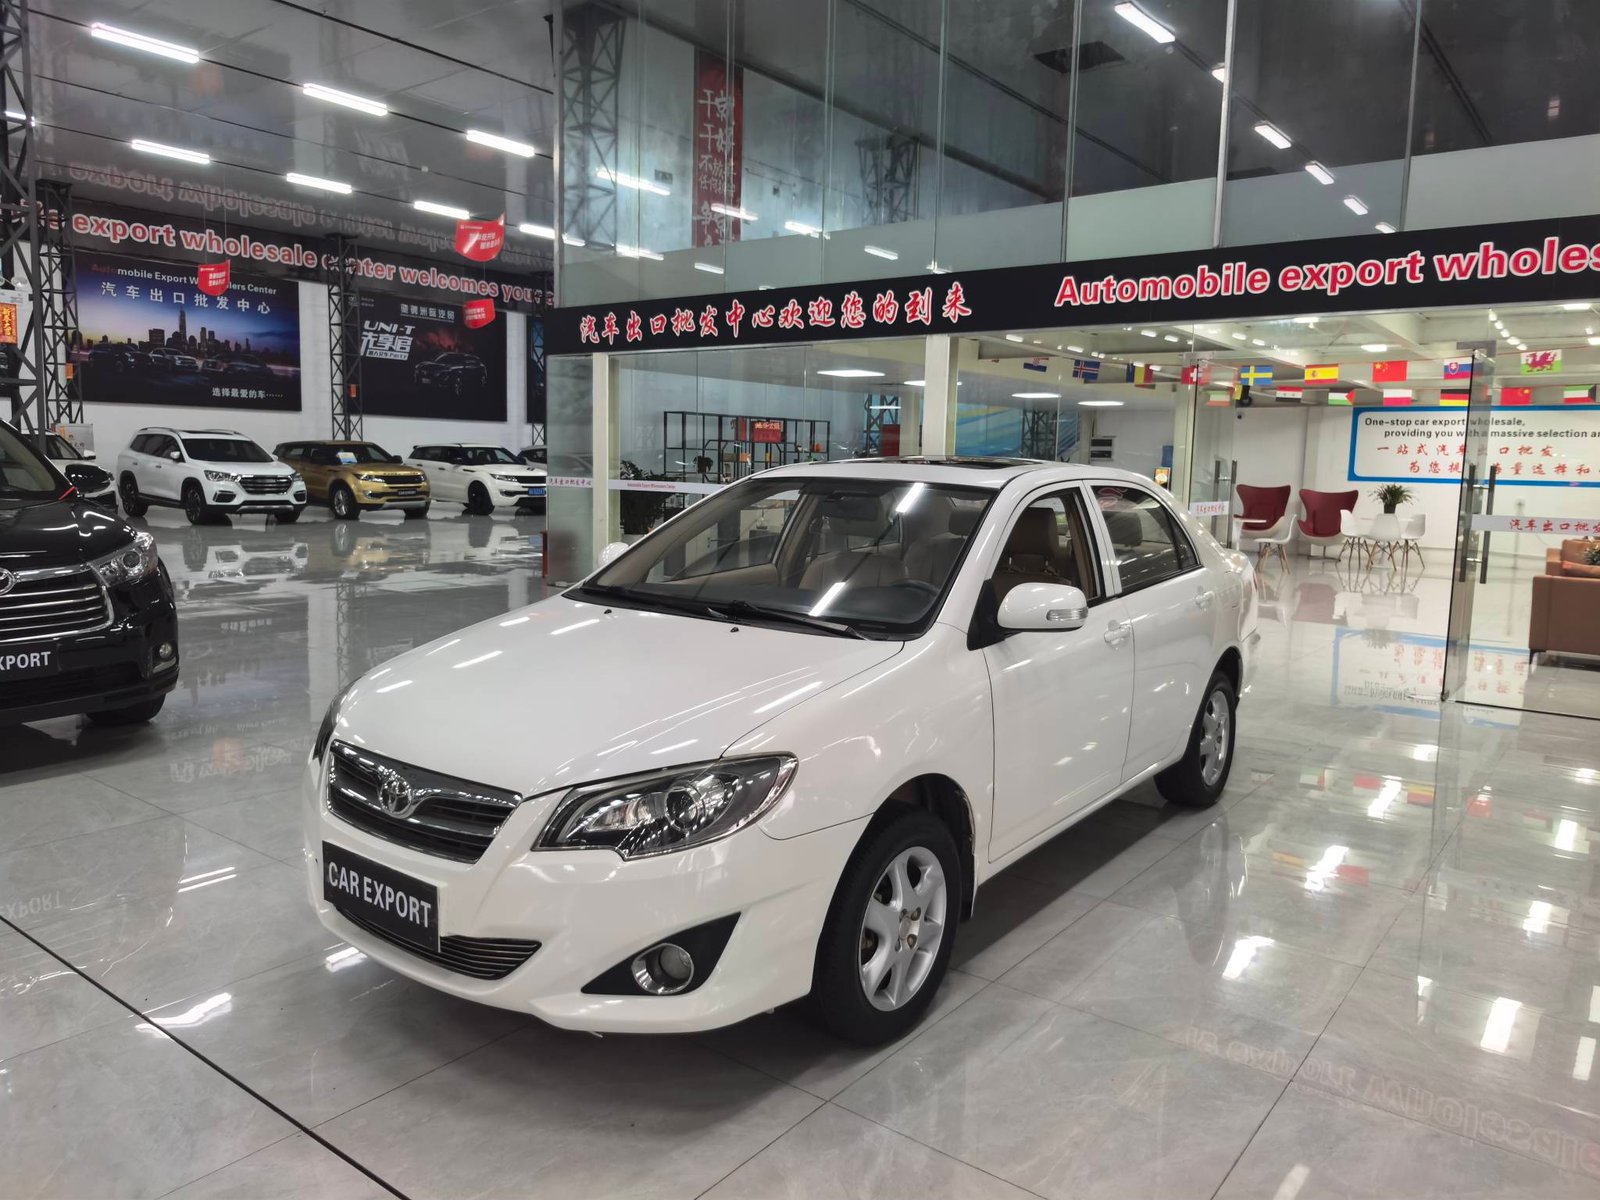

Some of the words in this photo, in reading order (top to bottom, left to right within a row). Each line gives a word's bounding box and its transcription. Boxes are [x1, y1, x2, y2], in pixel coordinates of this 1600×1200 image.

[72, 213, 176, 247] export
[180, 229, 317, 270] wholesale
[399, 266, 499, 298] welcomes
[92, 264, 153, 279] Automobile
[154, 271, 188, 284] Export
[247, 283, 277, 295] Center
[1054, 261, 1270, 307] Automobile
[1278, 250, 1425, 295] export
[101, 281, 271, 315] 汽车出口批发中心
[579, 281, 972, 345] 汽车出口批发中心欢迎您的到来
[363, 320, 416, 335] UNI-T
[1365, 417, 1412, 427] One-stop
[1432, 418, 1465, 427] export
[1470, 417, 1526, 427] wholesale,
[1384, 429, 1432, 439] providing
[1490, 429, 1534, 437] massive
[1537, 429, 1587, 438] selection
[328, 861, 359, 898] CAR
[363, 875, 431, 928] EXPORT
